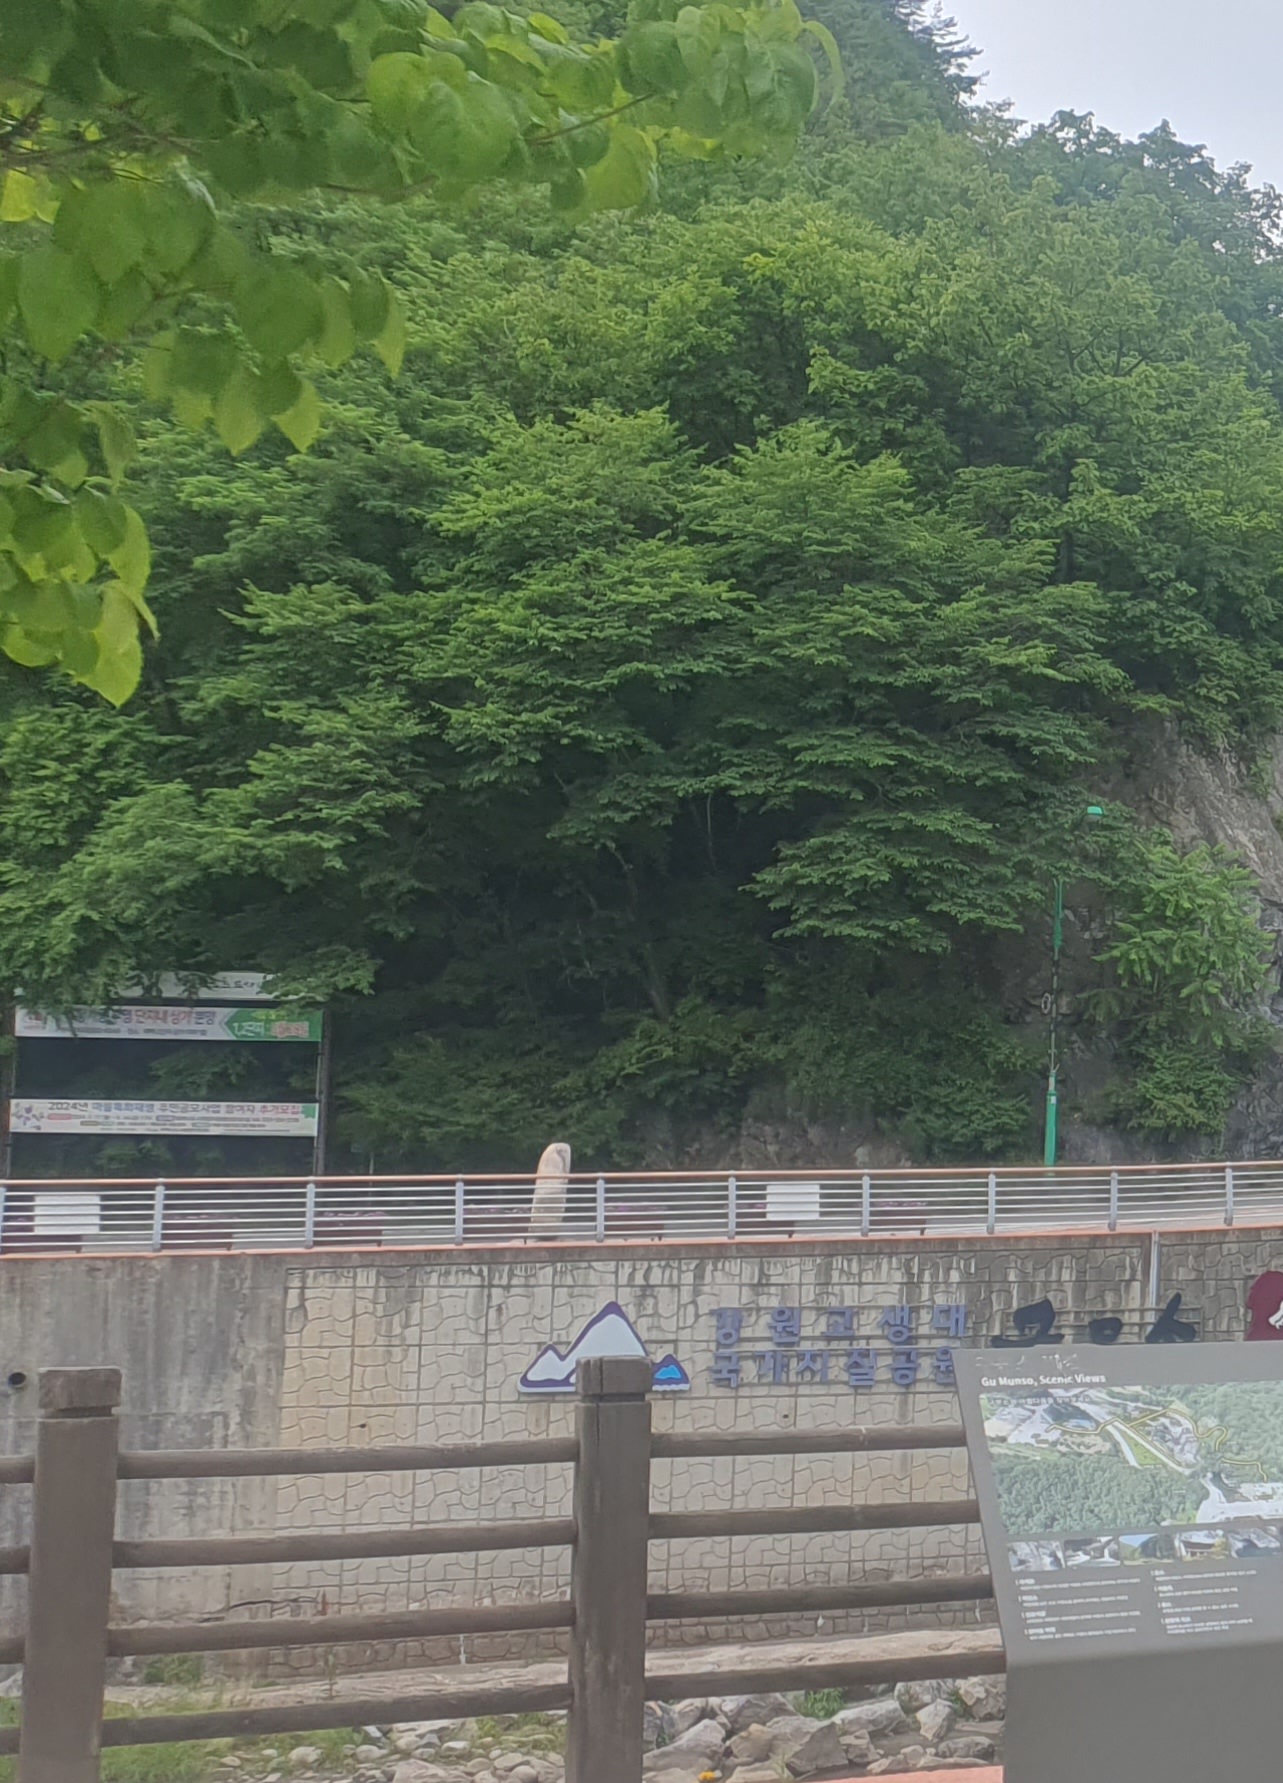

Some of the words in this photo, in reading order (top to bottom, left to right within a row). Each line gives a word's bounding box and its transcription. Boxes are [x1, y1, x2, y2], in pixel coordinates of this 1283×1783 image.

[48, 1101, 88, 1112] 2024년
[712, 1304, 967, 1347] 강원고생대
[713, 1346, 956, 1388] 국가지질공원
[981, 1376, 997, 1387] Gu
[998, 1375, 1038, 1387] Munso,
[1039, 1373, 1073, 1385] Scenic
[1074, 1372, 1106, 1383] Views
